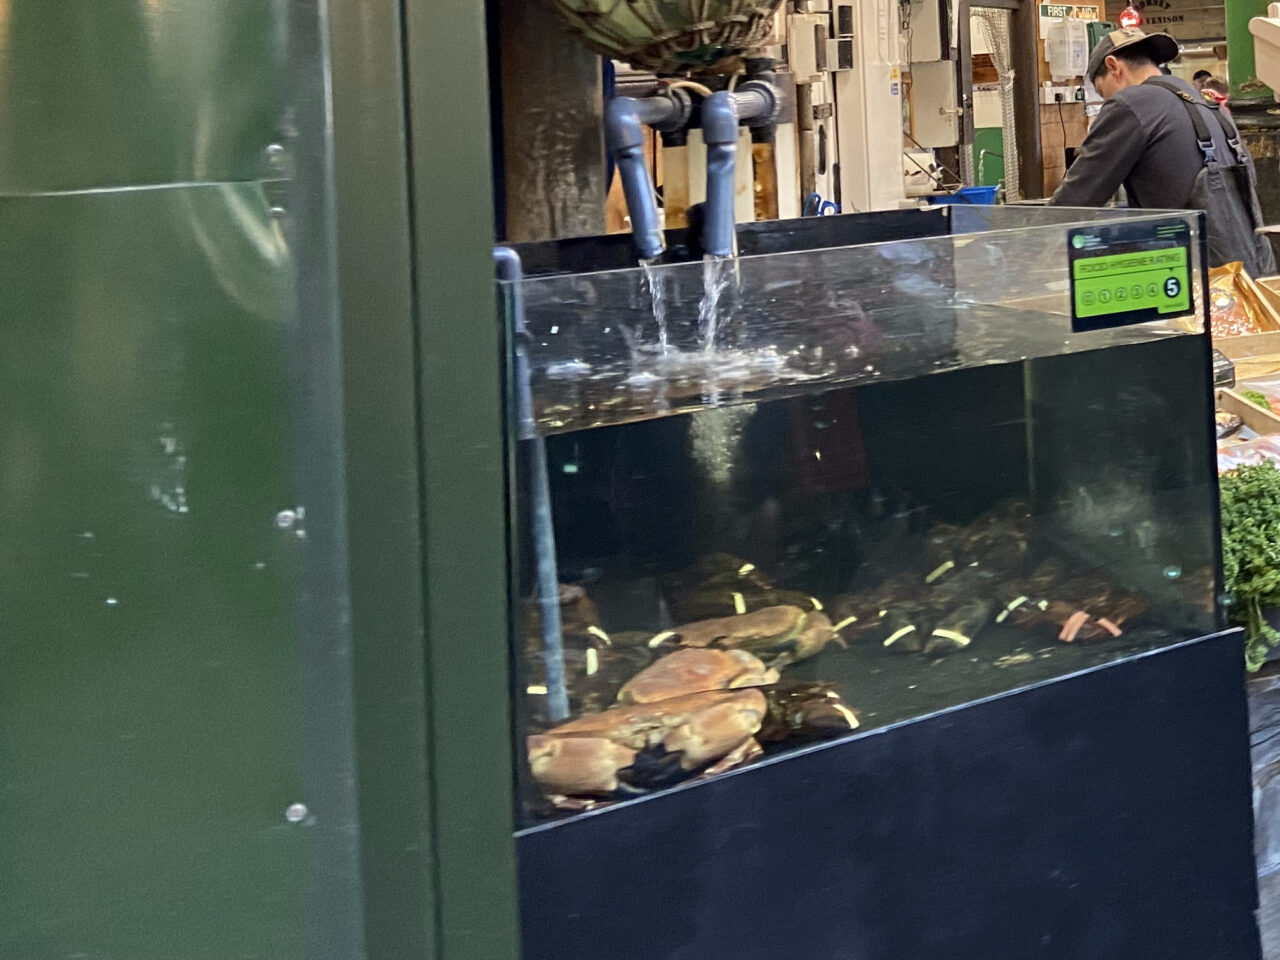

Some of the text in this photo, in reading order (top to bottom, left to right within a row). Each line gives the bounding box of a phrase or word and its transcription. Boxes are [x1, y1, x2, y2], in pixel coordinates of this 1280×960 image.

[1047, 5, 1067, 17] FIRST
[1146, 14, 1185, 25] VENISON
[1149, 252, 1182, 264] RATING
[1166, 278, 1178, 297] 5
